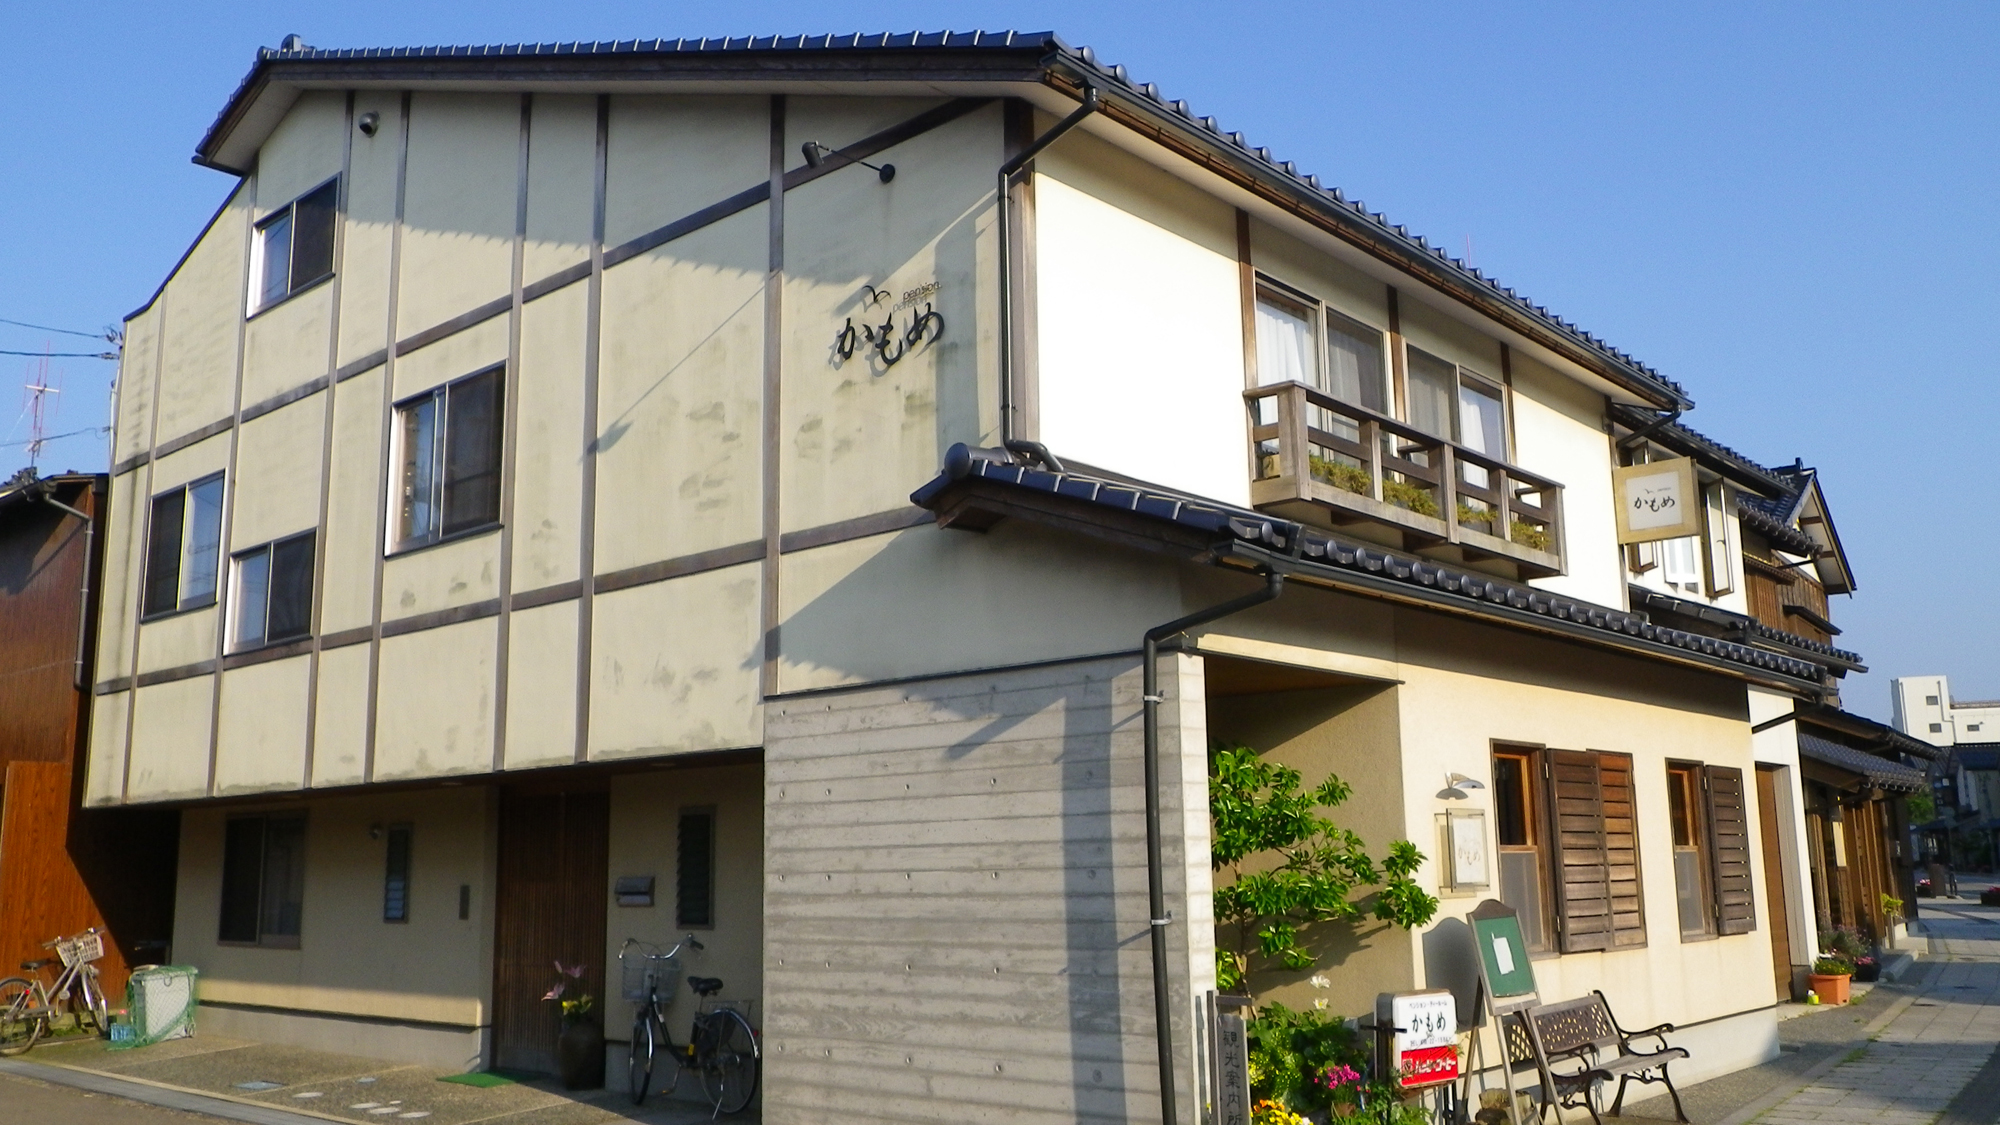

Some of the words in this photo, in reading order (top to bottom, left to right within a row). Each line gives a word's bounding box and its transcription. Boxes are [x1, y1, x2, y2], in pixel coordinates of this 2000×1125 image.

[903, 281, 940, 302] pension
[838, 302, 944, 366] かもめ
[1634, 496, 1675, 512] かもめ
[1412, 1011, 1446, 1033] かもめ
[1223, 1030, 1243, 1125] 観光案内所
